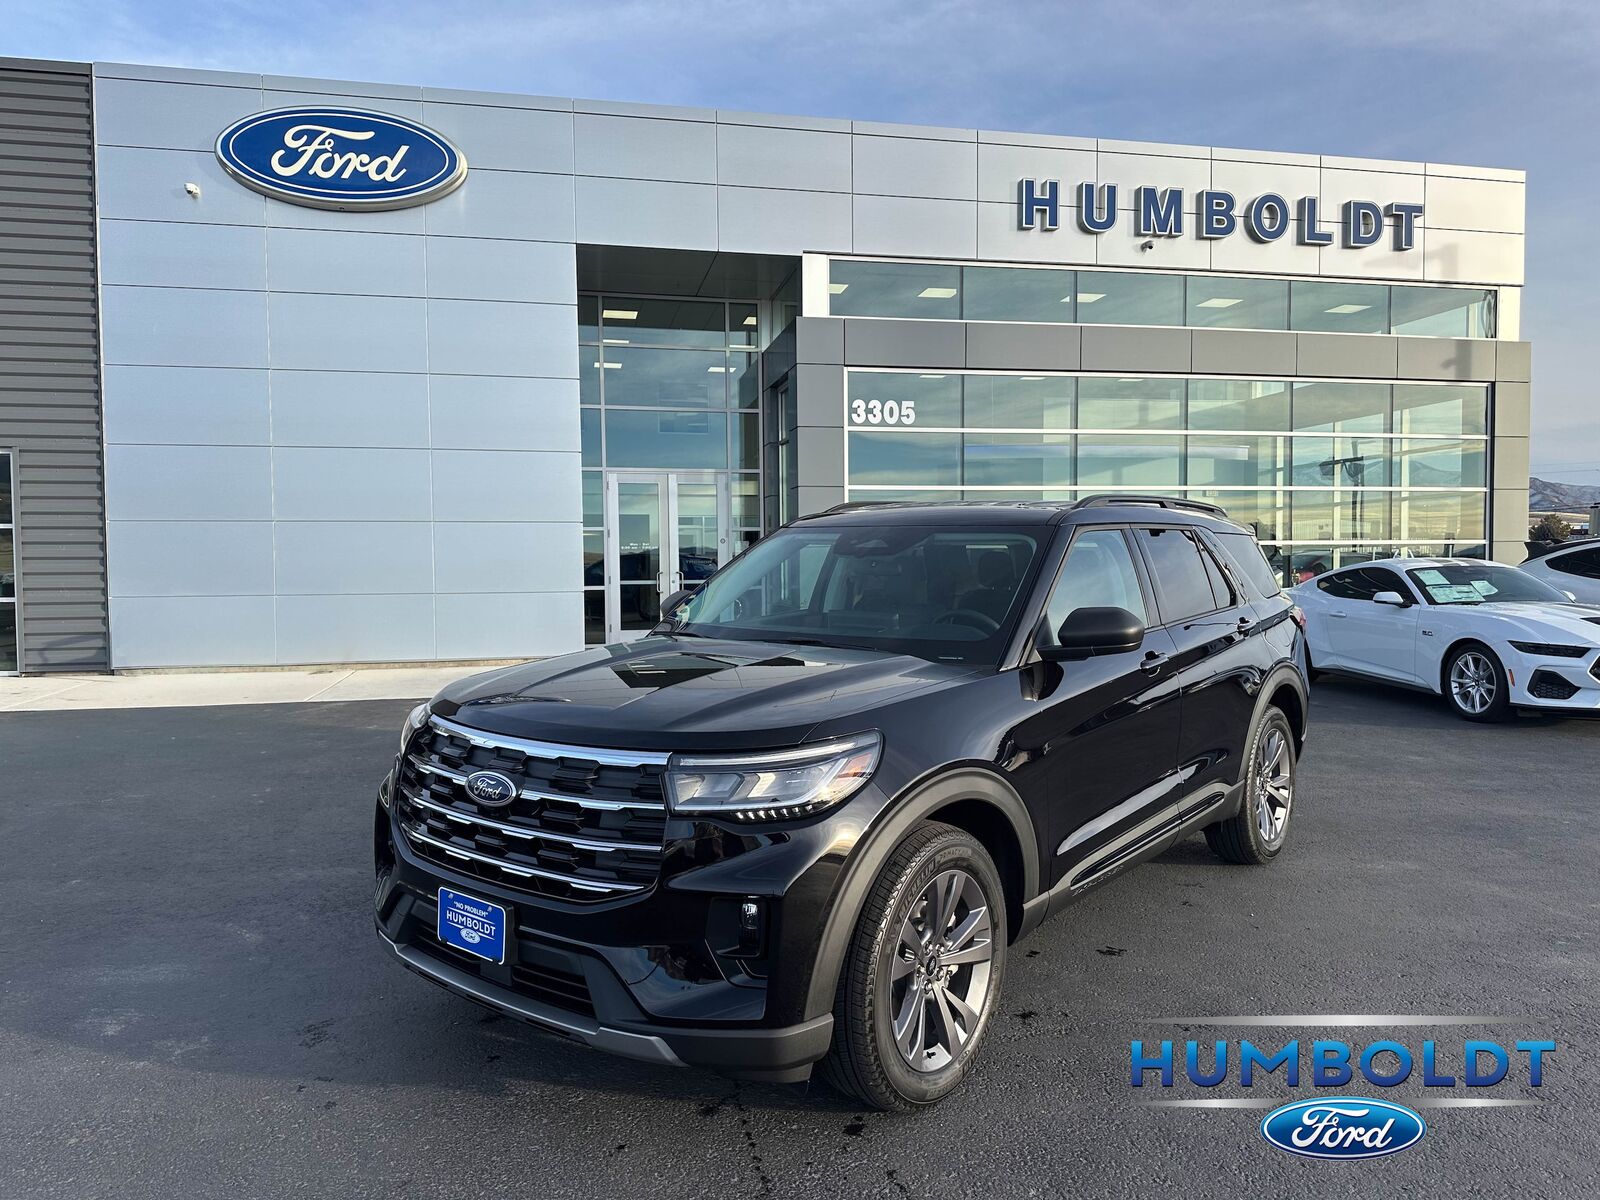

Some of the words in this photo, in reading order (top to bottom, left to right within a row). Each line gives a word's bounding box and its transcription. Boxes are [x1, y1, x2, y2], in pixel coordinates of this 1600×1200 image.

[270, 124, 410, 182] Ford
[1017, 178, 1424, 251] HUMBOLDT
[851, 399, 916, 425] 3305
[473, 777, 503, 799] Ford
[446, 910, 496, 936] HUMBOLDT
